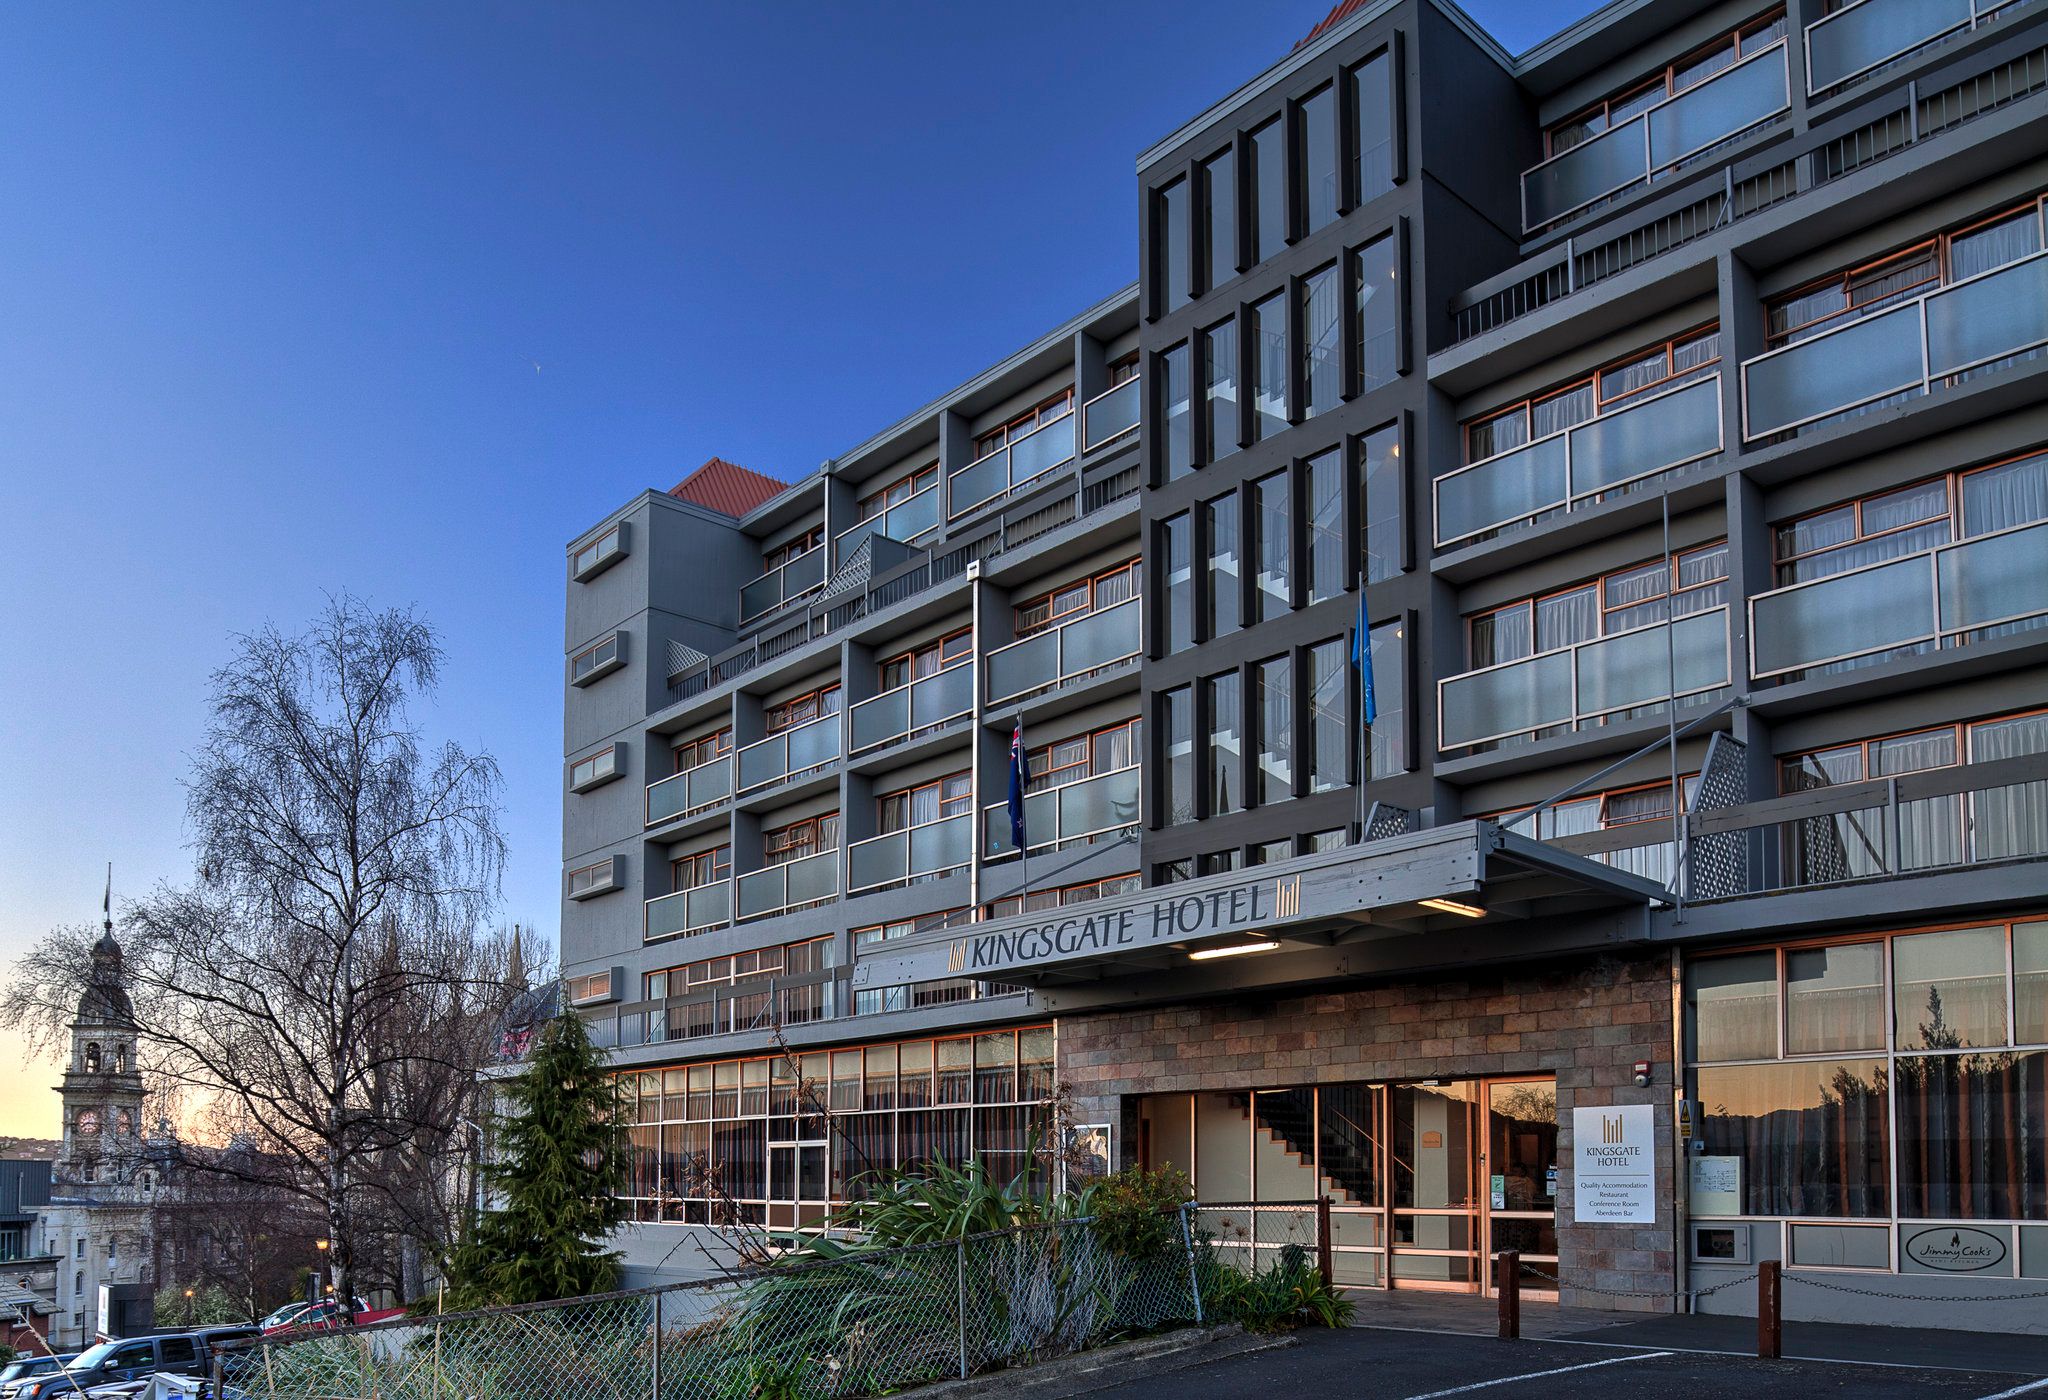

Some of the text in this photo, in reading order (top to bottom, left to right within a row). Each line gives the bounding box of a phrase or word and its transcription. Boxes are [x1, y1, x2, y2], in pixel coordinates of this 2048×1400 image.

[972, 885, 1268, 968] KINGSGATE HOTEL
[1586, 1147, 1640, 1156] KINGSGATE
[1597, 1157, 1629, 1166] HOTEL
[1580, 1182, 1601, 1190] Quality
[1920, 1244, 1992, 1260] Jimmy Cook's
